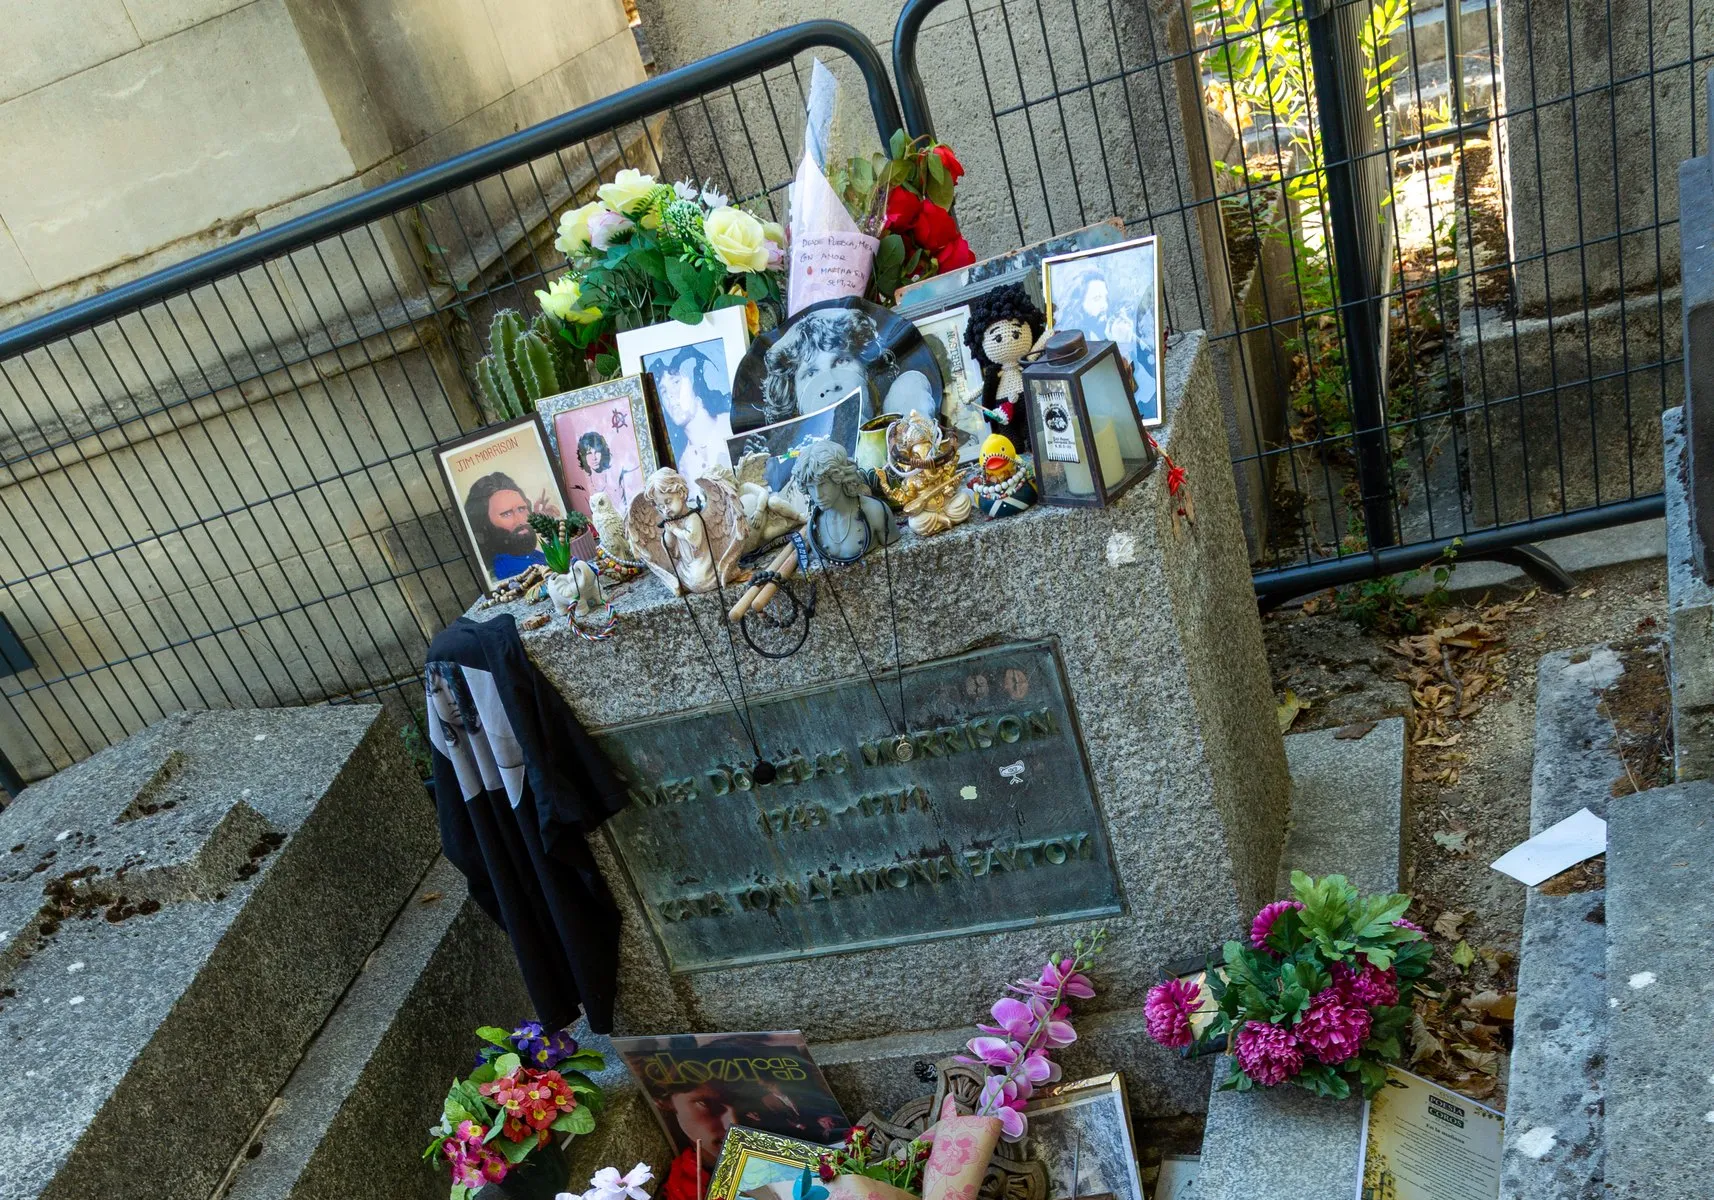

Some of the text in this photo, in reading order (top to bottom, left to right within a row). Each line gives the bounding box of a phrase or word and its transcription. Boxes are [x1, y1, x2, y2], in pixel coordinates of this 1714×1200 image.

[456, 436, 519, 473] JIM MORRISON
[704, 747, 850, 797] DOGLAS
